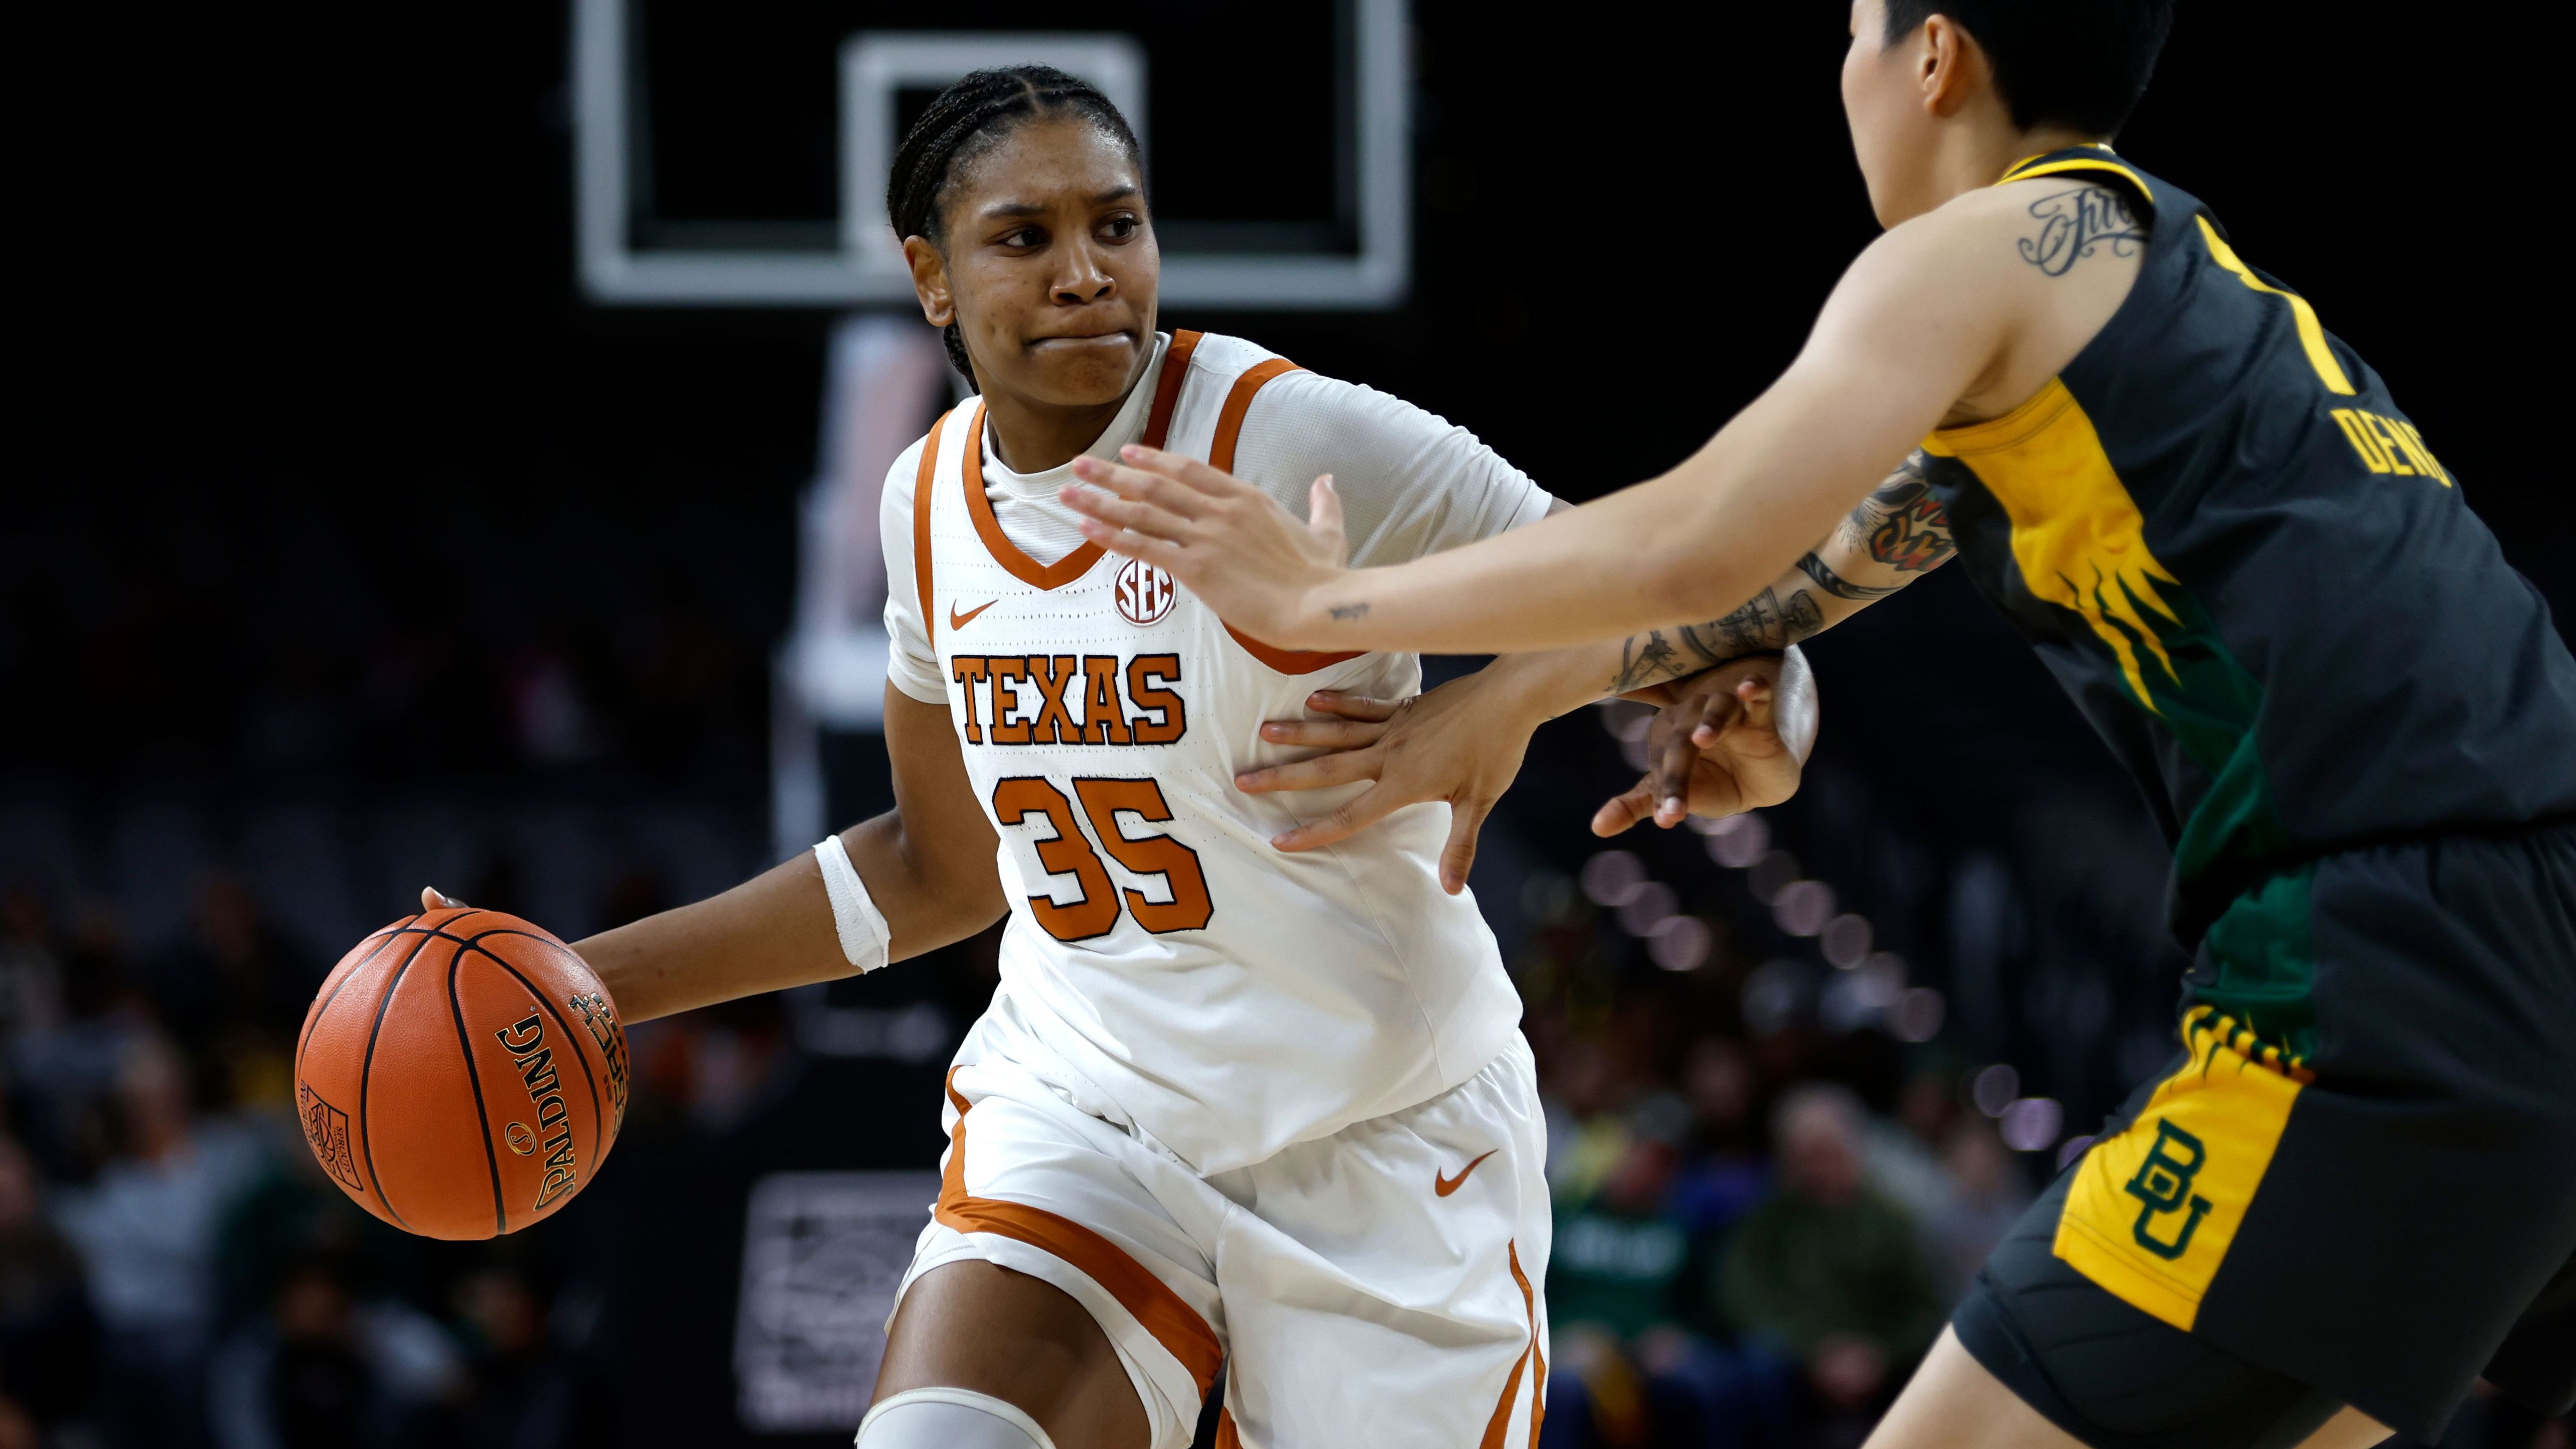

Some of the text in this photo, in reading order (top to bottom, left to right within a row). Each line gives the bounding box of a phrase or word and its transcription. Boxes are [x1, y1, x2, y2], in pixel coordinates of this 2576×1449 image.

[1118, 558, 1171, 621] SEC
[951, 653, 1187, 747] TEXAS
[992, 776, 1215, 943] 35
[336, 1125, 353, 1175] SPROUTS
[494, 1012, 577, 1212] SPALDING
[2124, 1116, 2214, 1261] BU
